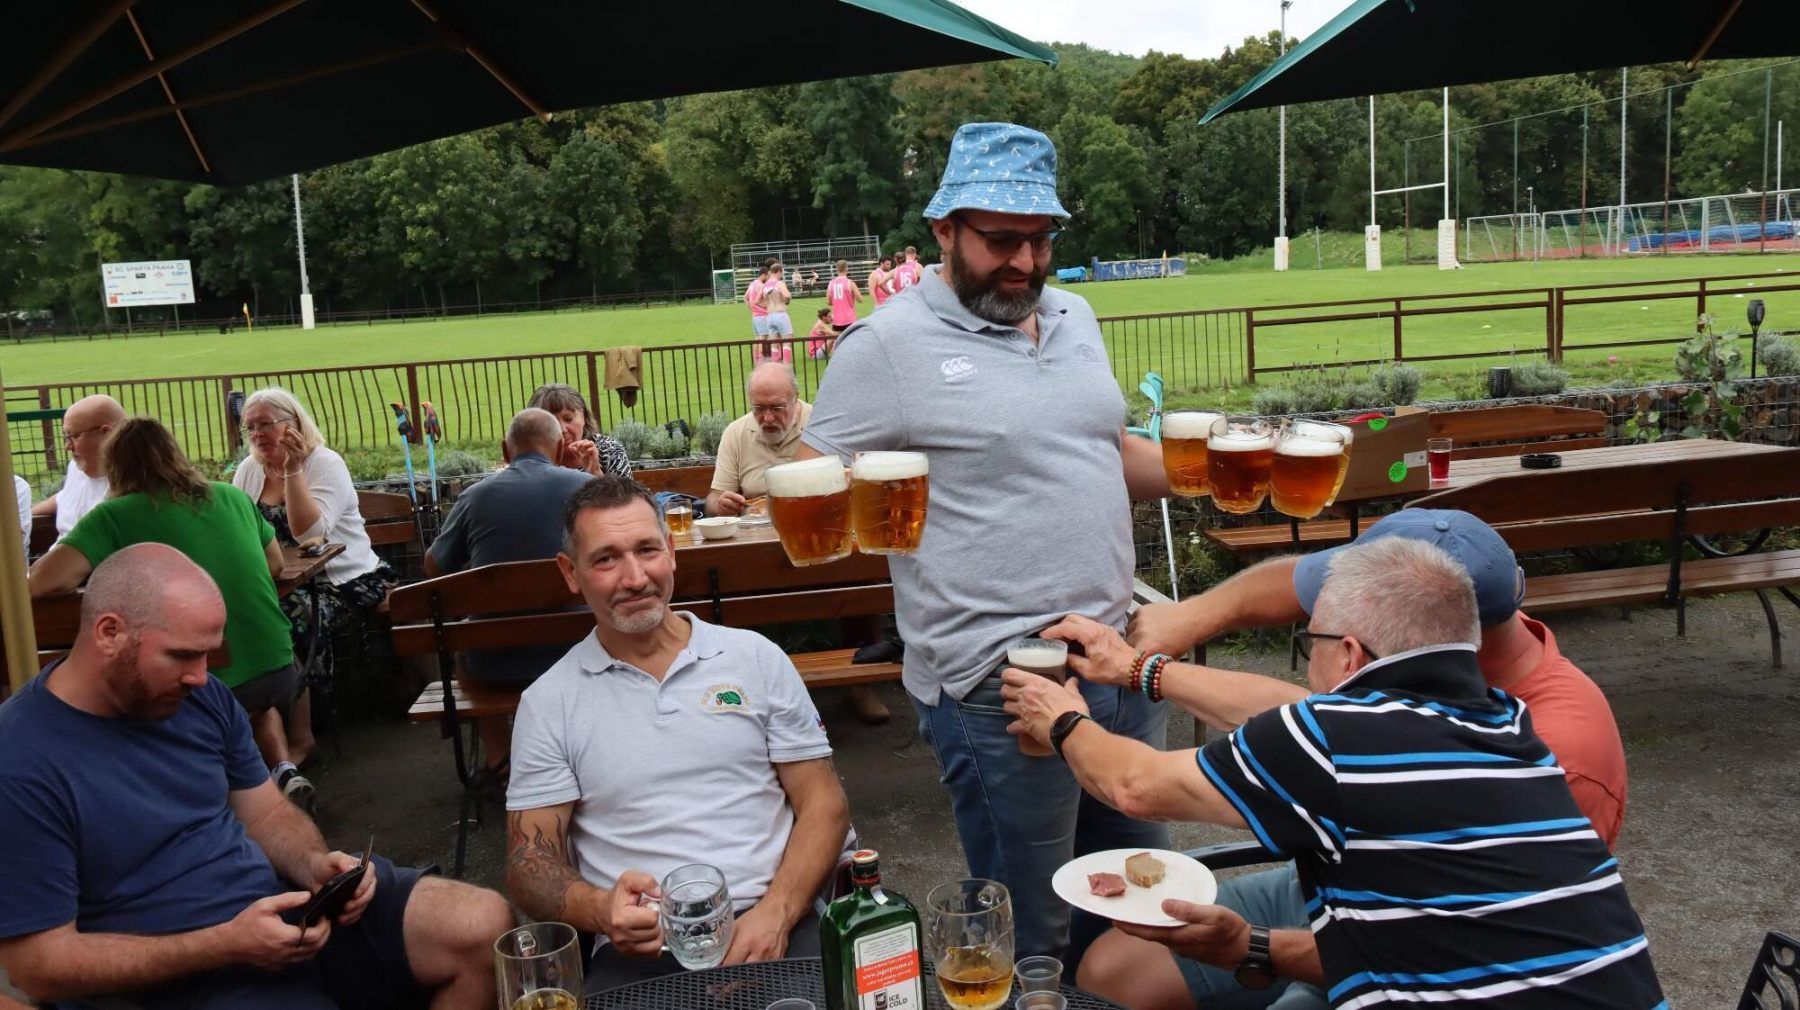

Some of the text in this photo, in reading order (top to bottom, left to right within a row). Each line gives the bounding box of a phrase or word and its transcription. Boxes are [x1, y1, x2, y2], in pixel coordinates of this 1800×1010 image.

[900, 272, 912, 287] 16
[833, 283, 843, 300] 10
[889, 993, 900, 1002] ICE
[889, 997, 908, 1008] COLD
